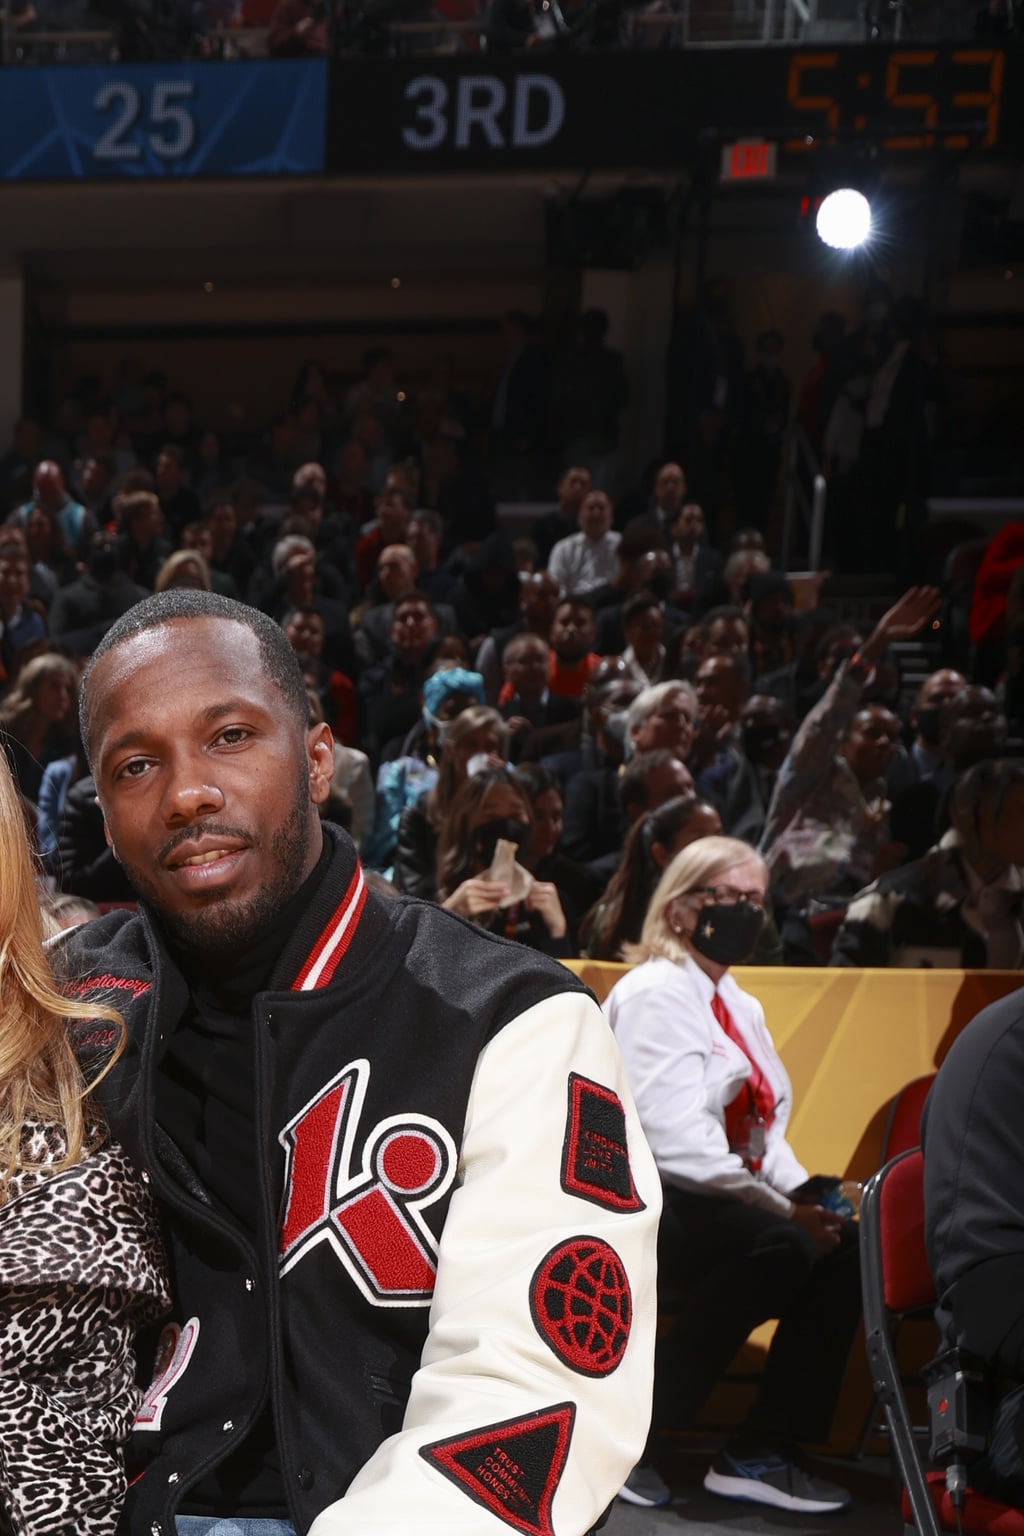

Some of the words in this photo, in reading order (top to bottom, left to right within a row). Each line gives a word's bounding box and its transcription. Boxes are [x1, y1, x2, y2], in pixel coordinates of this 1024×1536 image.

[93, 81, 197, 159] 25
[402, 74, 566, 150] 3RD
[782, 48, 1007, 152] 5:53
[730, 143, 770, 179] EXIT
[477, 1465, 521, 1507] HONEST
[493, 1447, 525, 1478] TRUST
